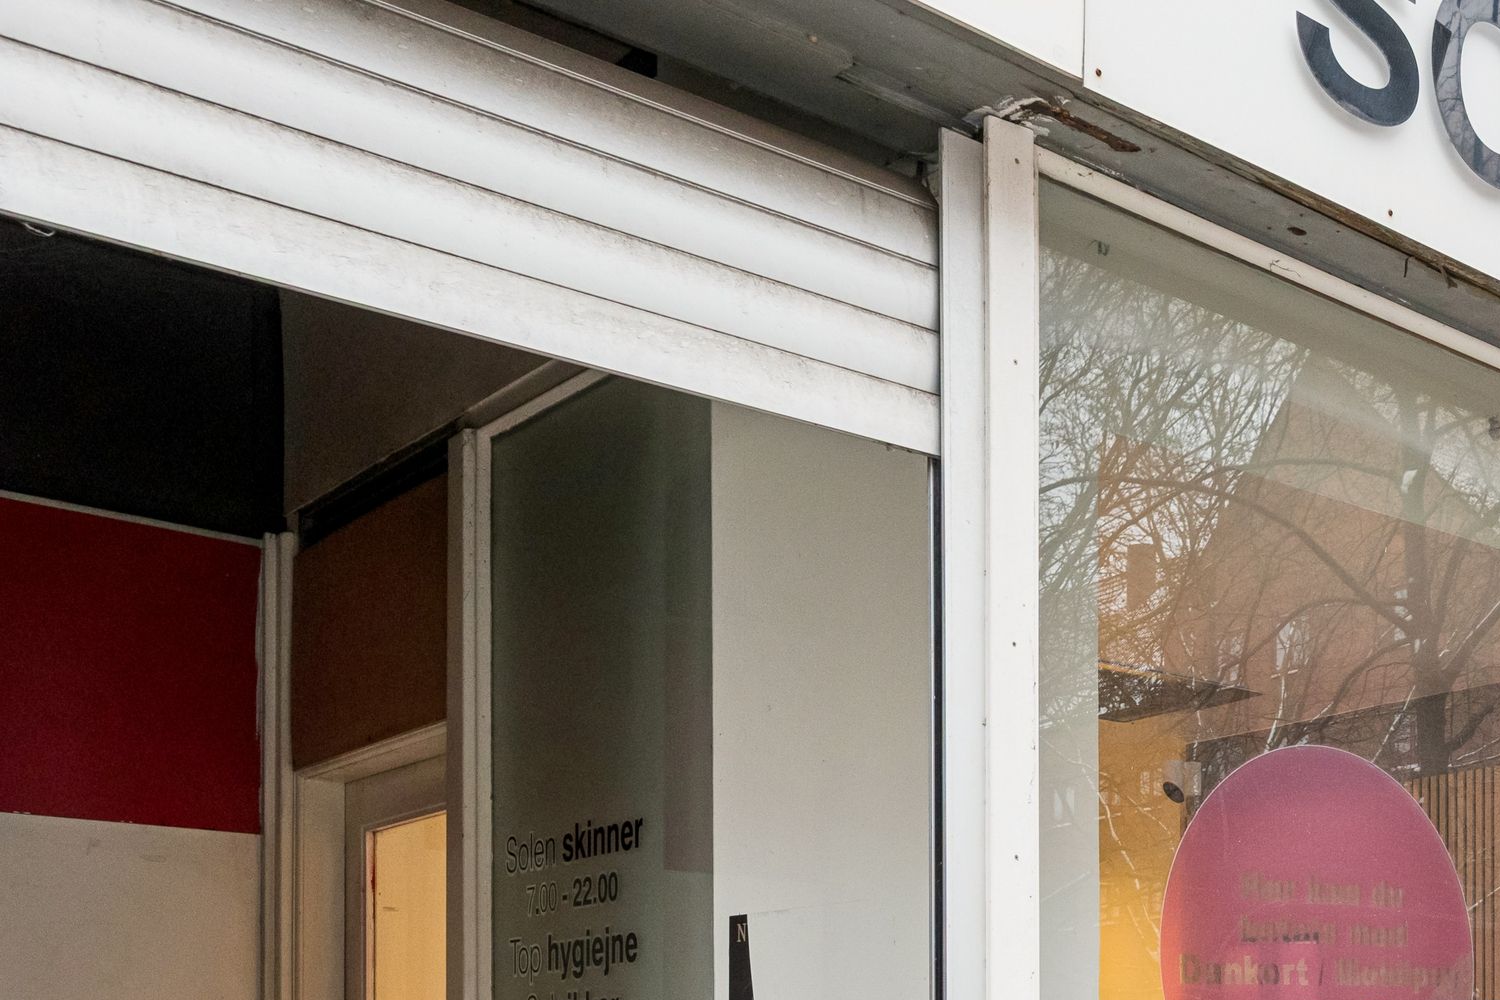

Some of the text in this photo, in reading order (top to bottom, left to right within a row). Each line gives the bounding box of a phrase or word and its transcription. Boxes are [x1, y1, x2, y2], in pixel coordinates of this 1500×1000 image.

[506, 818, 643, 874] Solen skinner
[526, 882, 557, 917] 7.00
[573, 871, 618, 907] 22.00
[510, 926, 638, 983] Top hygiejne
